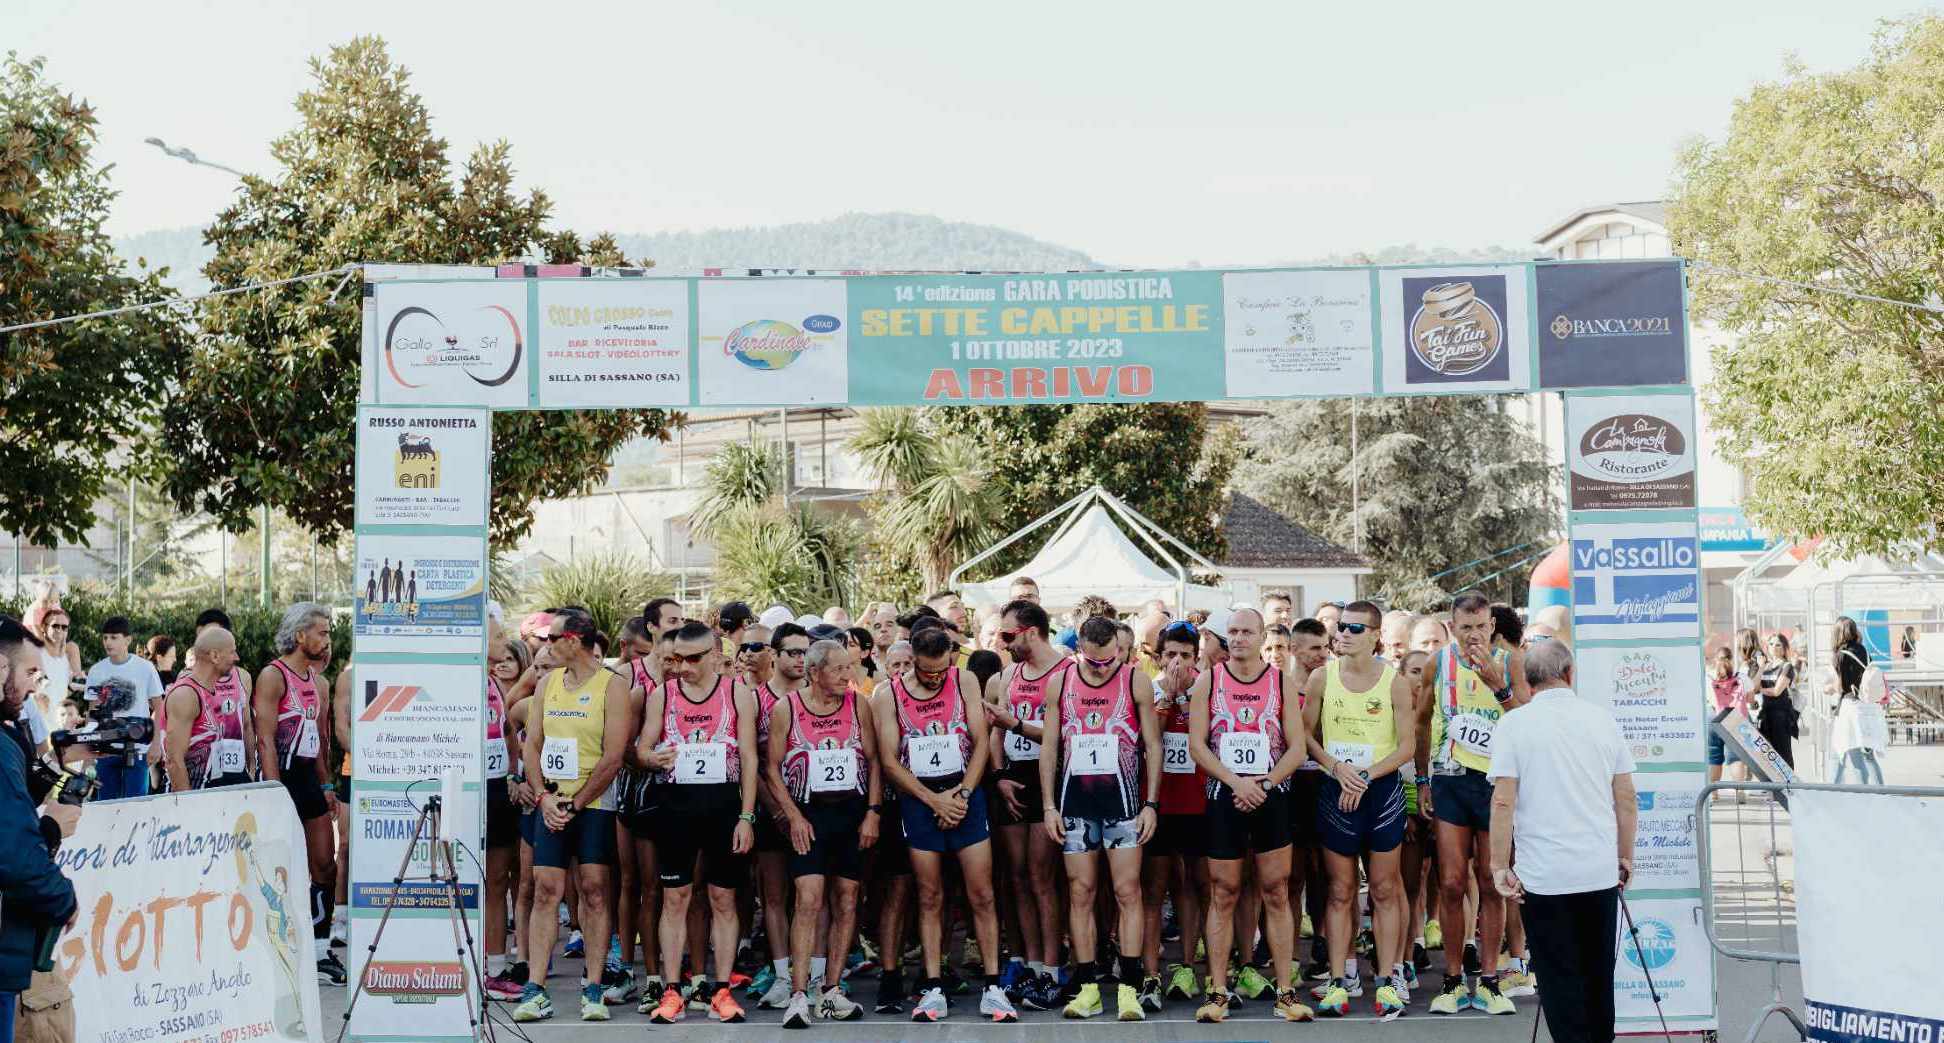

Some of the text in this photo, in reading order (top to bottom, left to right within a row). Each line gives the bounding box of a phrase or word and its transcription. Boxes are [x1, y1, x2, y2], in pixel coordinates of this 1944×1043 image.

[1004, 280, 1061, 301] GARA
[1067, 278, 1173, 300] PODISTICA
[862, 304, 1208, 336] SETTE CAPPELLE
[394, 337, 433, 350] Gallo
[480, 336, 498, 350] Srl
[951, 338, 1123, 360] 1 OTTOBRE 2023
[440, 354, 481, 362] LIQUIGAS
[600, 373, 652, 382] SASSANO
[655, 372, 680, 382] (SA)
[923, 365, 1154, 400] ARRIVO
[369, 418, 477, 428] RUSSO ANTONIETTA
[1600, 458, 1668, 474] Ristorante
[399, 466, 435, 488] eni
[1577, 540, 1693, 569] vassallo
[1612, 699, 1668, 707] TABACCHI
[1014, 736, 1032, 752] 45
[1459, 725, 1491, 748] 102
[488, 755, 502, 771] 27
[547, 753, 565, 770] 96
[929, 751, 941, 767] 4
[1089, 749, 1097, 765] 1
[1167, 748, 1187, 764] 28
[1234, 748, 1256, 764] 30
[695, 760, 706, 775] 2
[825, 766, 846, 781] 23
[367, 966, 464, 989] Diano Salumi
[159, 1013, 204, 1036] SASSANO
